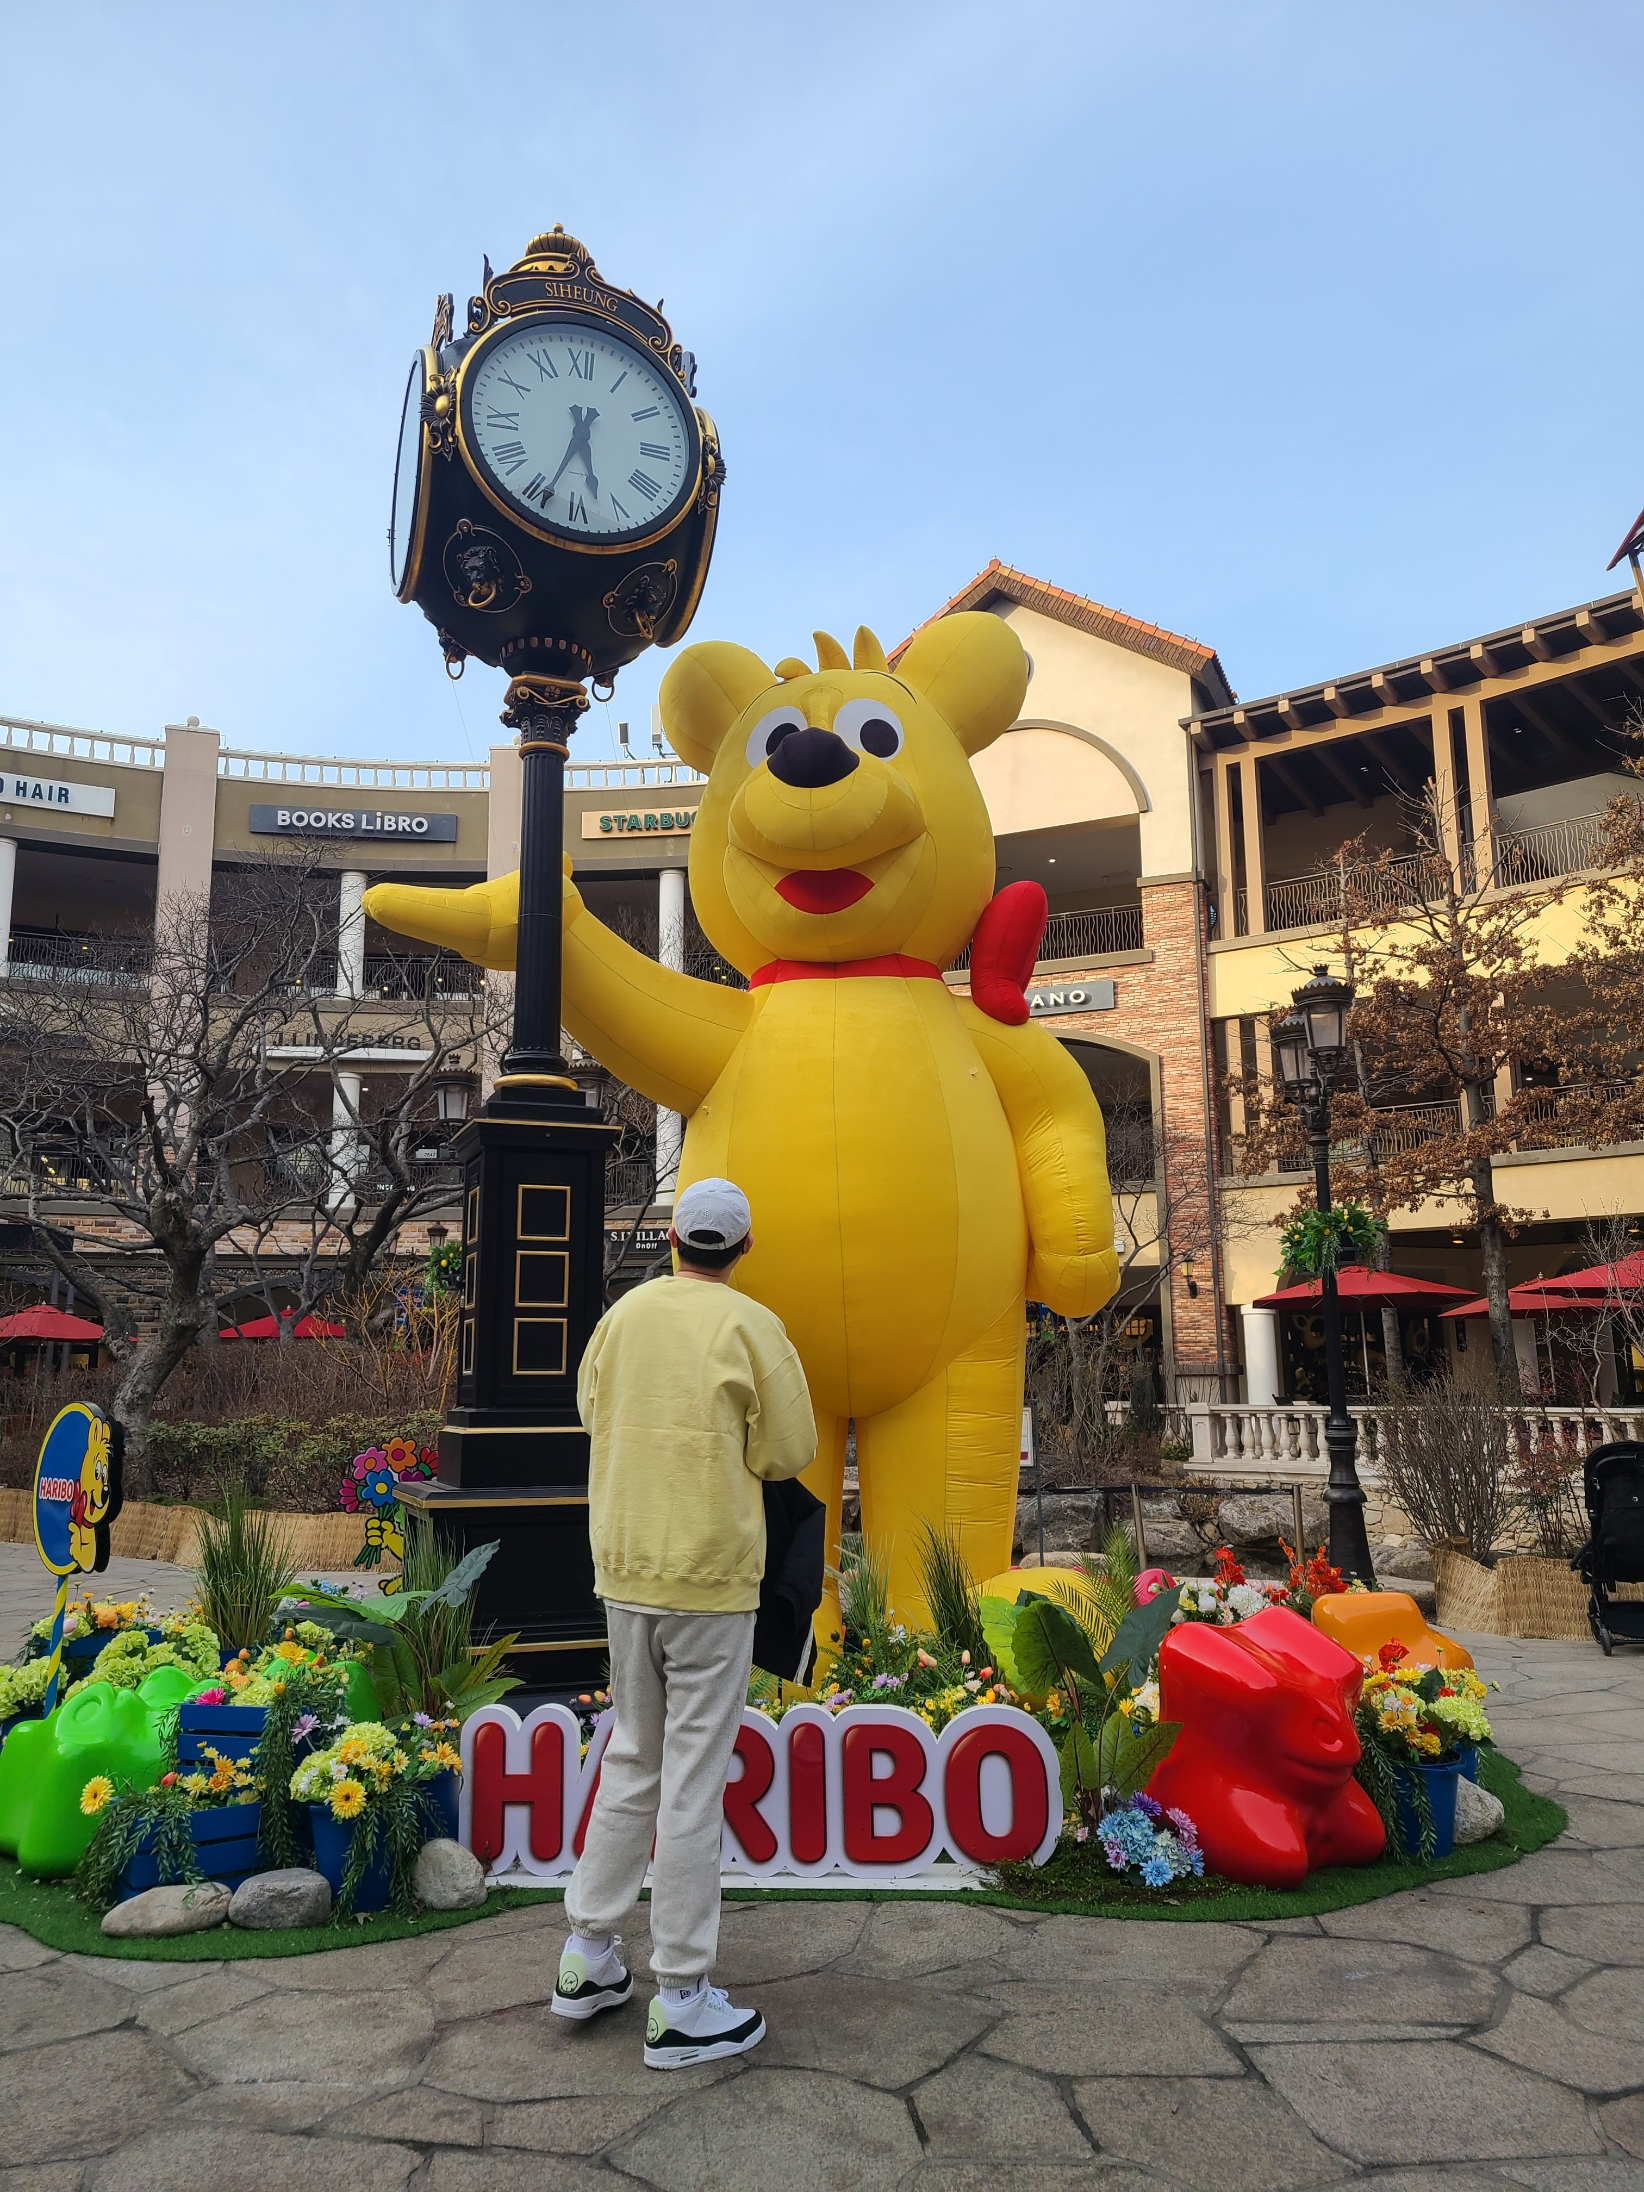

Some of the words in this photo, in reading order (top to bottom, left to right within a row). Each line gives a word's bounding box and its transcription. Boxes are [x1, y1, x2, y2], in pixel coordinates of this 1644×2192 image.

[545, 282, 619, 312] SIHEUNG
[567, 347, 595, 381] XII
[497, 369, 532, 400] X
[15, 780, 70, 804] HAIR
[277, 810, 355, 829] BOOKS
[635, 1242, 658, 1250] OnOff
[40, 1477, 74, 1501] HARIBO
[471, 1720, 1049, 1864] HRIBO
